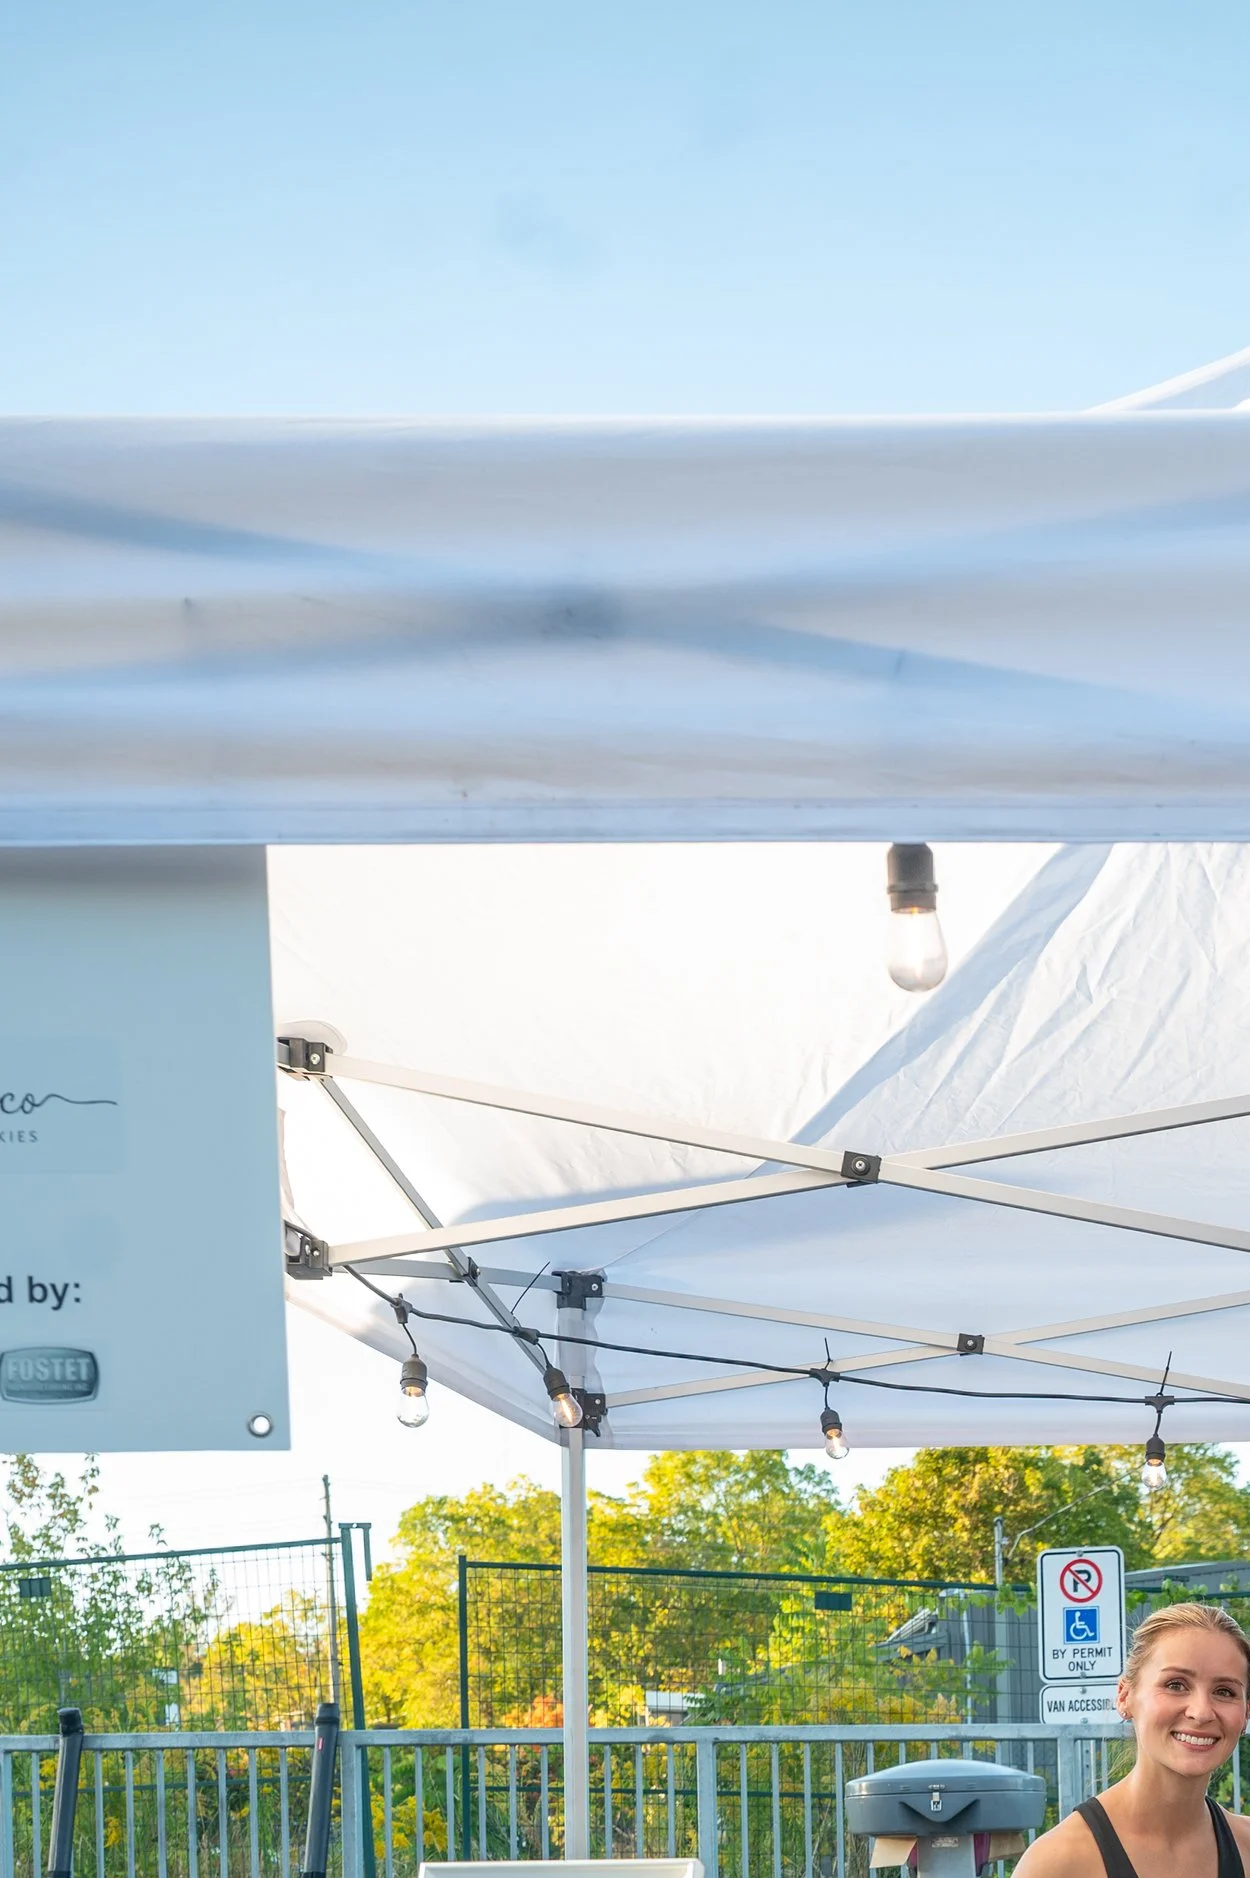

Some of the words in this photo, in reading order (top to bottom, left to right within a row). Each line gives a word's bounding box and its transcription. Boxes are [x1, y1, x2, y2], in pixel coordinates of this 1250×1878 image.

[0, 1130, 38, 1143] KIES
[28, 1275, 80, 1311] by:
[1052, 1649, 1067, 1660] BY
[1073, 1647, 1113, 1659] PERMIT
[1068, 1660, 1097, 1672] ONLY
[1047, 1700, 1065, 1713] VAN
[1068, 1698, 1117, 1712] ACCESSIBL
